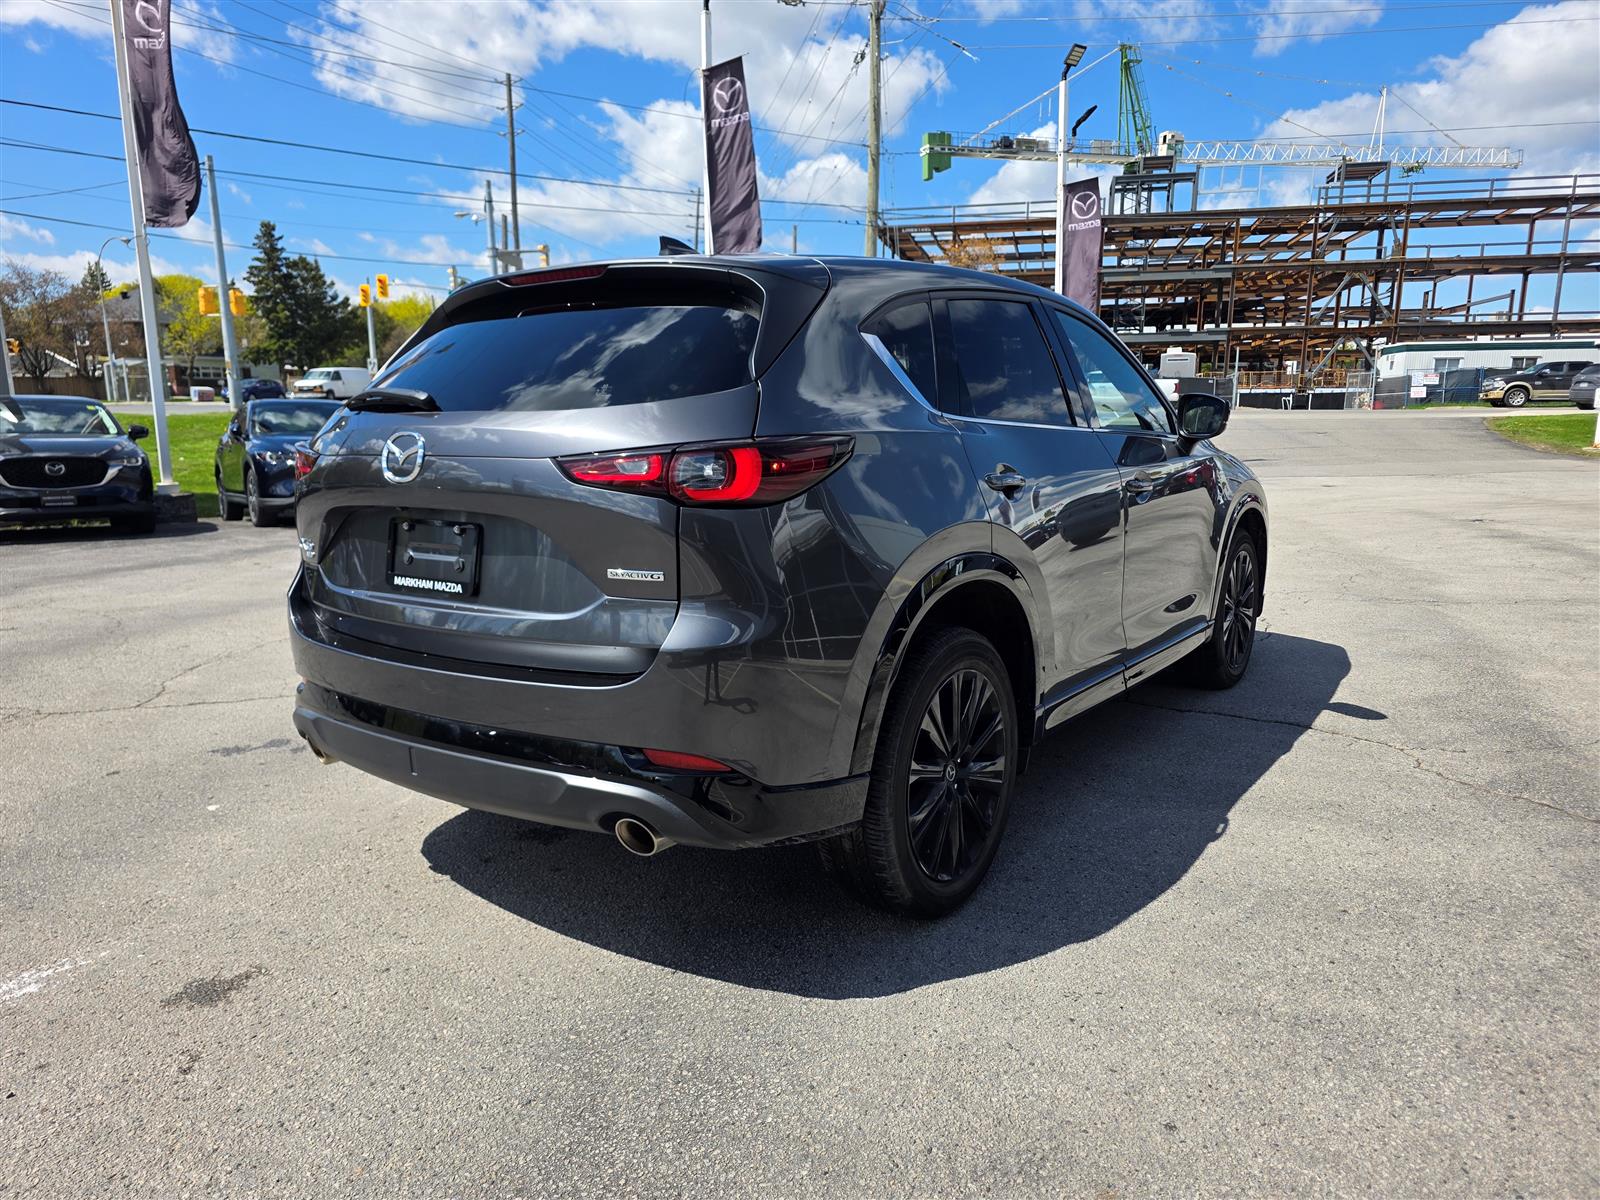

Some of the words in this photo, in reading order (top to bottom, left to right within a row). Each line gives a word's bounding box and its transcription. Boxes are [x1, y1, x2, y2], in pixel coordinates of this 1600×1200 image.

[711, 112, 749, 128] mazda
[1068, 219, 1101, 232] mazda
[393, 575, 433, 590] MARKHAM
[434, 580, 463, 594] MAZDA
